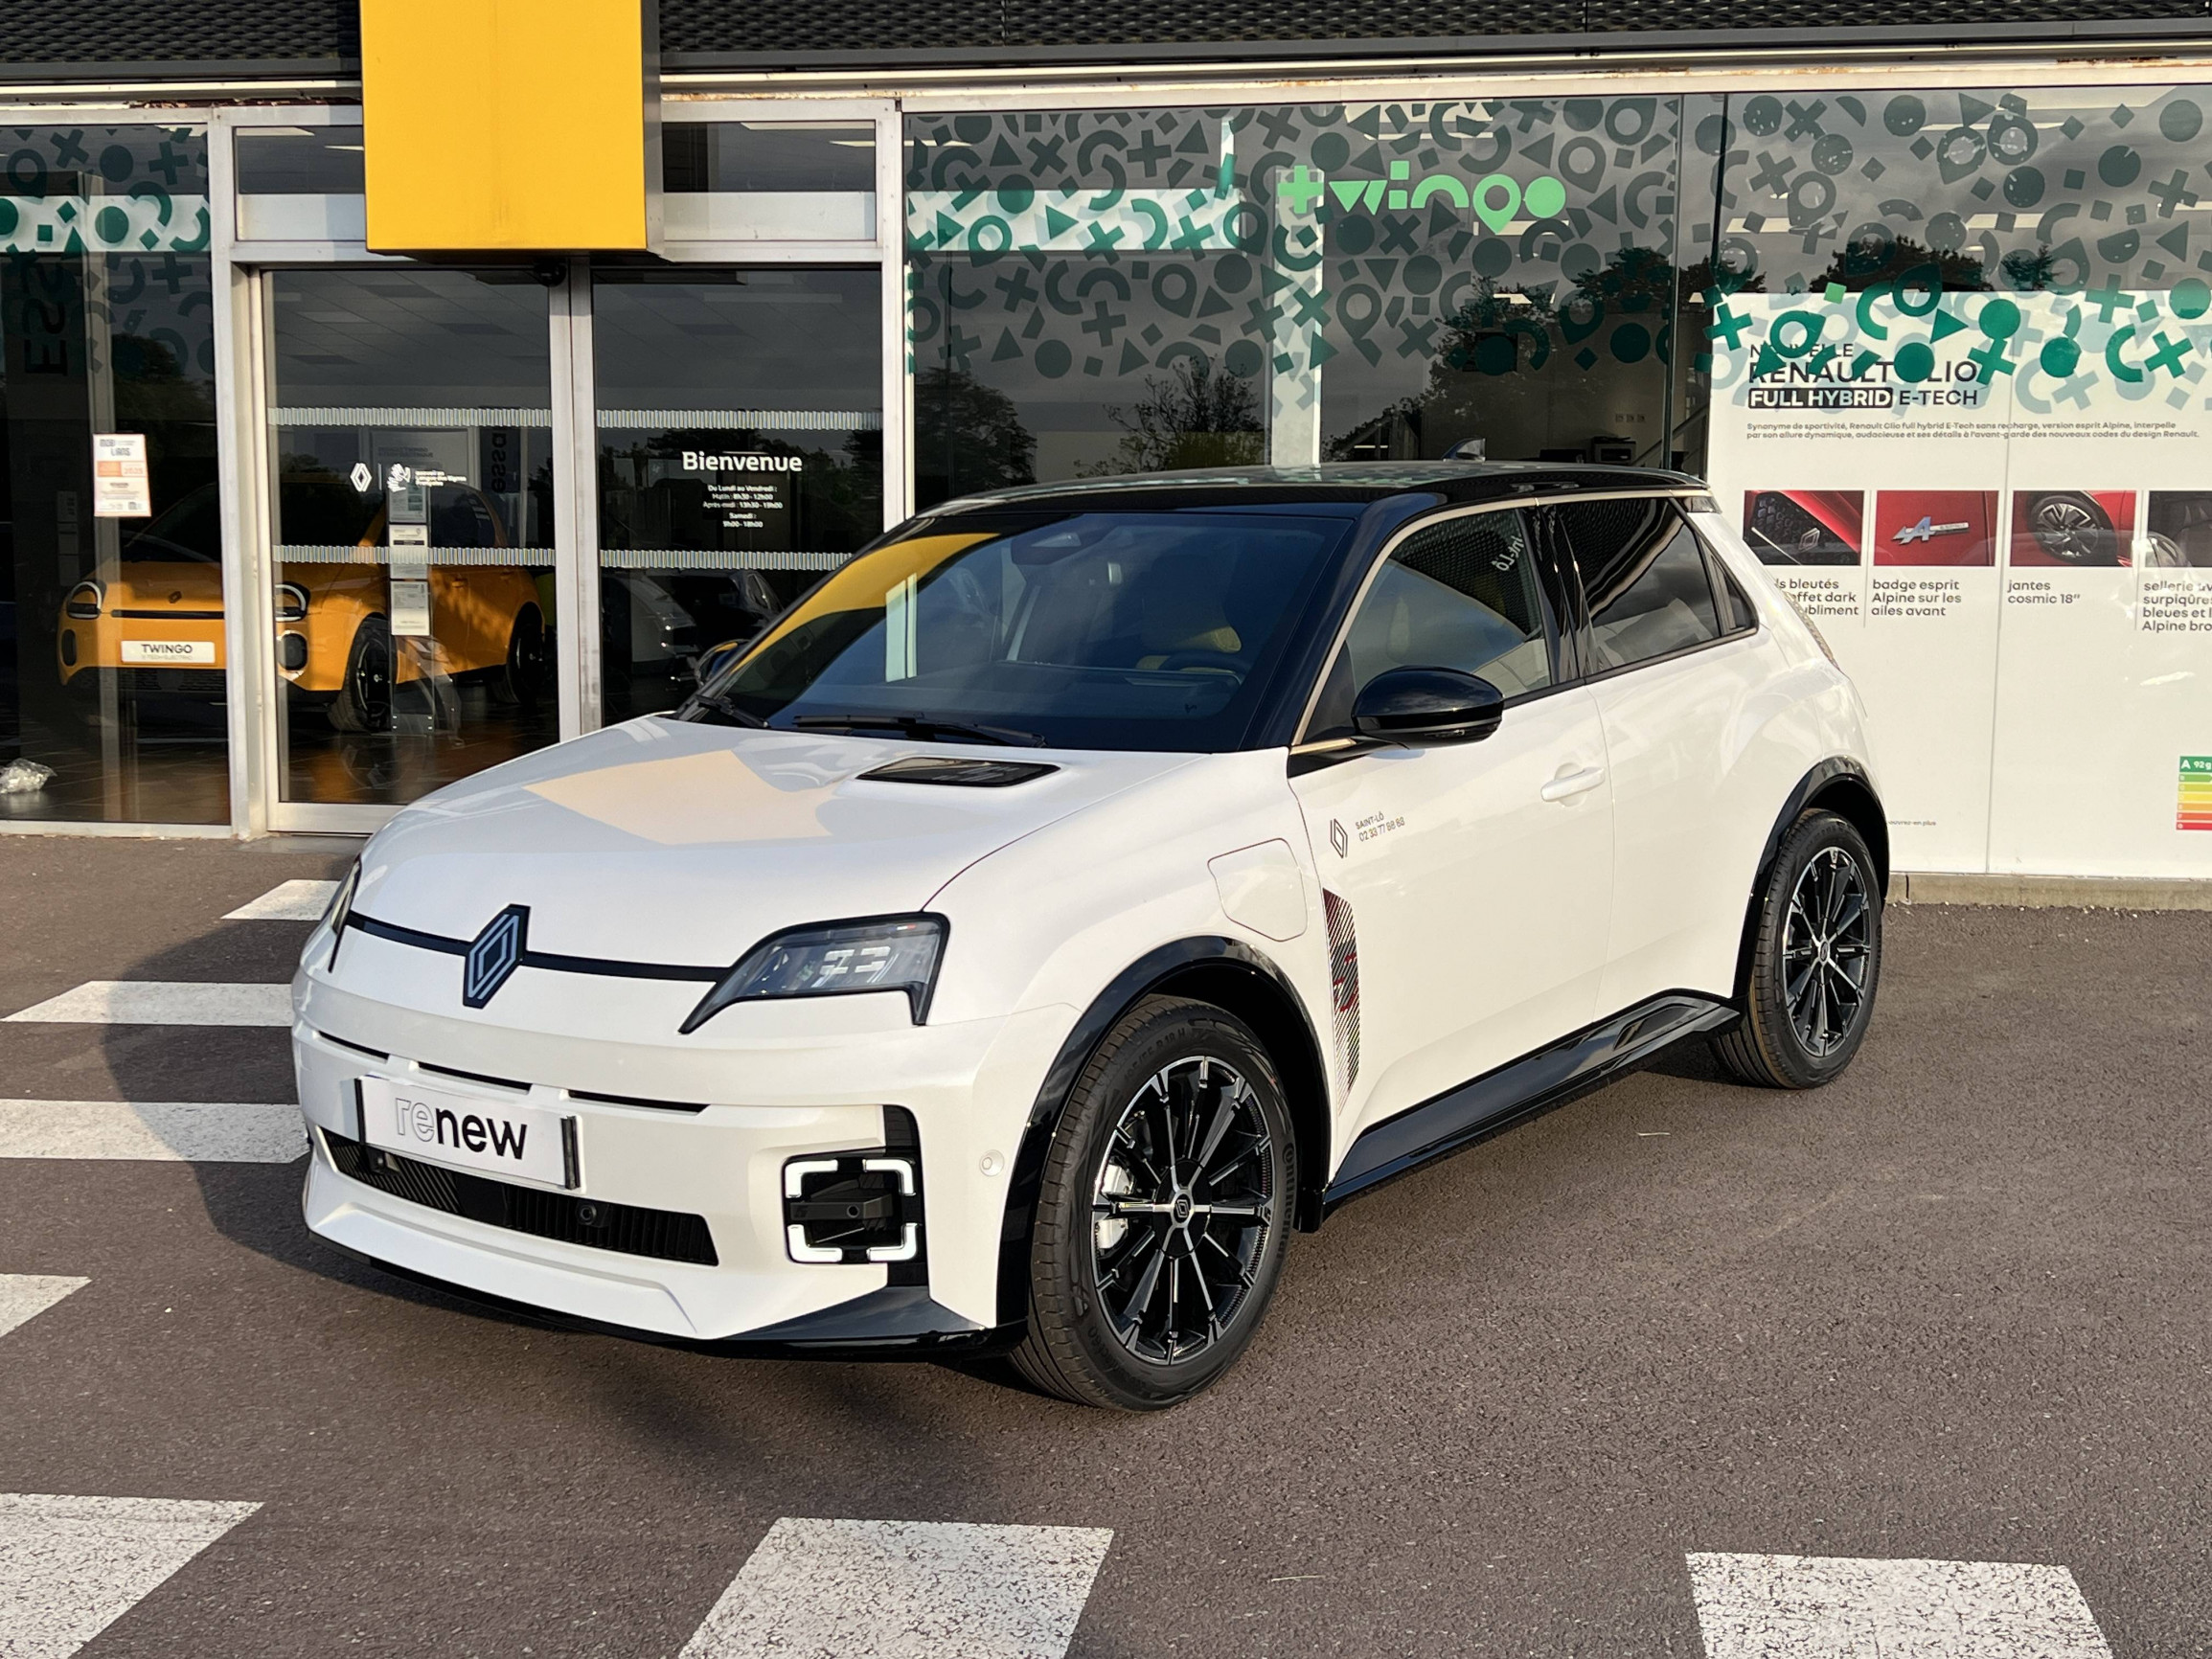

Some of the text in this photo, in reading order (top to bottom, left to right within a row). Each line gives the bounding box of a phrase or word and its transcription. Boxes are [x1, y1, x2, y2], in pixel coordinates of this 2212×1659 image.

[1750, 390, 1977, 406] FULL HYBRID E-TECH
[1805, 422, 1848, 431] sportivité,
[1916, 422, 1944, 430] hybrid
[682, 451, 802, 471] Bienvenue
[1790, 579, 1839, 589] bleutés
[1873, 579, 1959, 592] badge esprit
[2007, 580, 2050, 593] jantes
[2144, 580, 2193, 591] sellerie
[1825, 592, 1856, 602] dark
[1872, 592, 1915, 605] Alpine
[1943, 592, 1962, 603] les
[2008, 593, 2057, 603] cosmic
[1871, 605, 1946, 616] ailes avant
[2143, 607, 2188, 618] bleues
[2191, 609, 2205, 618] et
[2142, 620, 2212, 633] Alpine bro
[141, 644, 192, 653] TWINGO
[2181, 759, 2191, 769] A
[1355, 811, 1384, 830] SAINT-LÔ
[396, 1097, 527, 1160] renew
[1276, 1143, 1295, 1259] Continental
